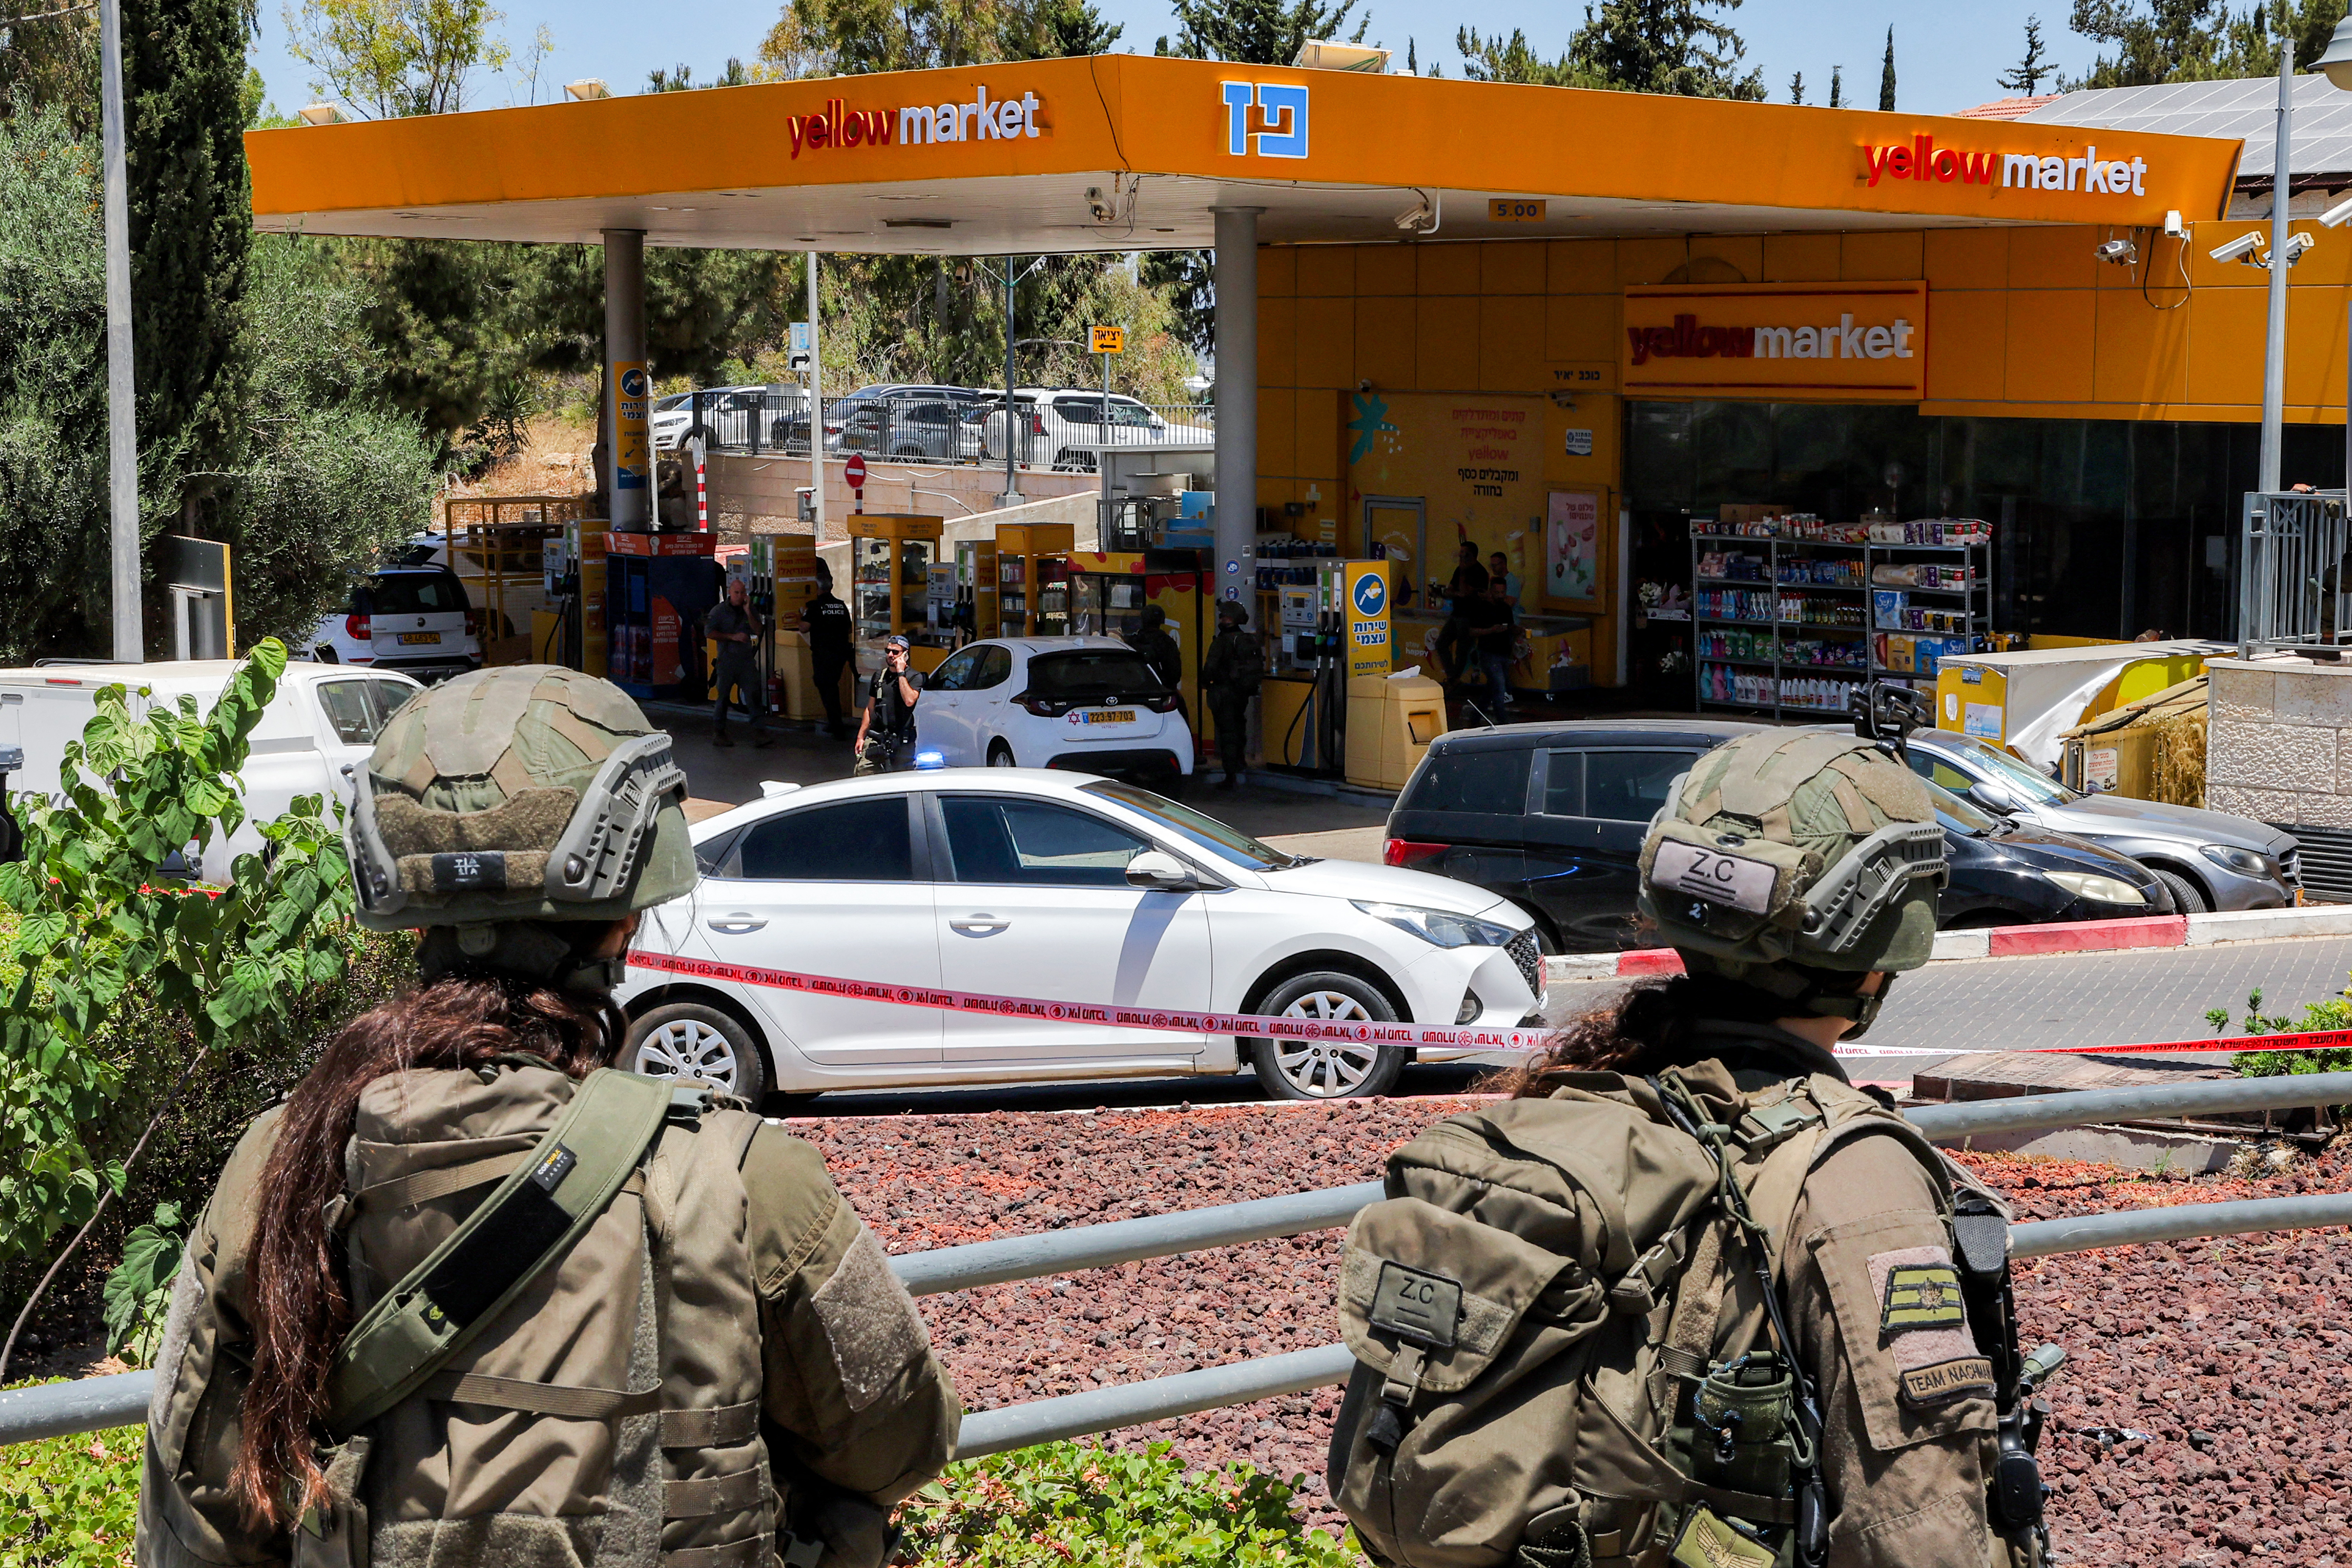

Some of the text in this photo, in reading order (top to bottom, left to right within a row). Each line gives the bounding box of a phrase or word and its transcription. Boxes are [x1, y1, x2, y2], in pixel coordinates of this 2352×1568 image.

[1219, 80, 1309, 159] פז
[1497, 204, 1537, 217] 5.00
[1095, 330, 1120, 341] יציאה
[1554, 370, 1601, 380] כוכב יאיר
[1468, 445, 1509, 461] yellow
[1458, 468, 1519, 483] ומקבלים כסף
[1474, 485, 1502, 496] בחזרה
[1353, 621, 1387, 633] שירות
[1356, 633, 1386, 645] עצמי
[1688, 851, 1735, 882] Z.C
[764, 972, 778, 985] אין
[779, 975, 804, 988] מעבר
[812, 979, 846, 994] משטרת
[864, 986, 895, 1001] ישראל
[916, 992, 929, 1004] אין
[930, 993, 955, 1007] מעבר
[964, 996, 998, 1011] משטרת
[1016, 1003, 1047, 1018] ישראל
[1068, 1007, 1081, 1020] אין
[1082, 1009, 1108, 1022] מעבר
[1117, 1011, 1151, 1025] משטרת
[1169, 1015, 1199, 1031] ישראל
[1221, 1018, 1234, 1031] אין
[1235, 1020, 1260, 1033] מעבר
[1269, 1022, 1303, 1036] משטרת
[1321, 1025, 1352, 1041] ישראל
[1374, 1027, 1386, 1040] אין
[1388, 1029, 1413, 1042] מעבר
[1422, 1031, 1456, 1044] משטרת
[1474, 1033, 1504, 1047] ישראל
[1526, 1034, 1539, 1047] אין
[2214, 1037, 2244, 1049] ישראל
[2263, 1036, 2298, 1048] משטרת
[2308, 1034, 2333, 1046] מעבר
[2335, 1033, 2347, 1045] אין
[2179, 1043, 2191, 1051] אין
[537, 1148, 562, 1175] CORDURA
[1399, 1276, 1434, 1304] Z.C
[1908, 1370, 1946, 1392] TEAM
